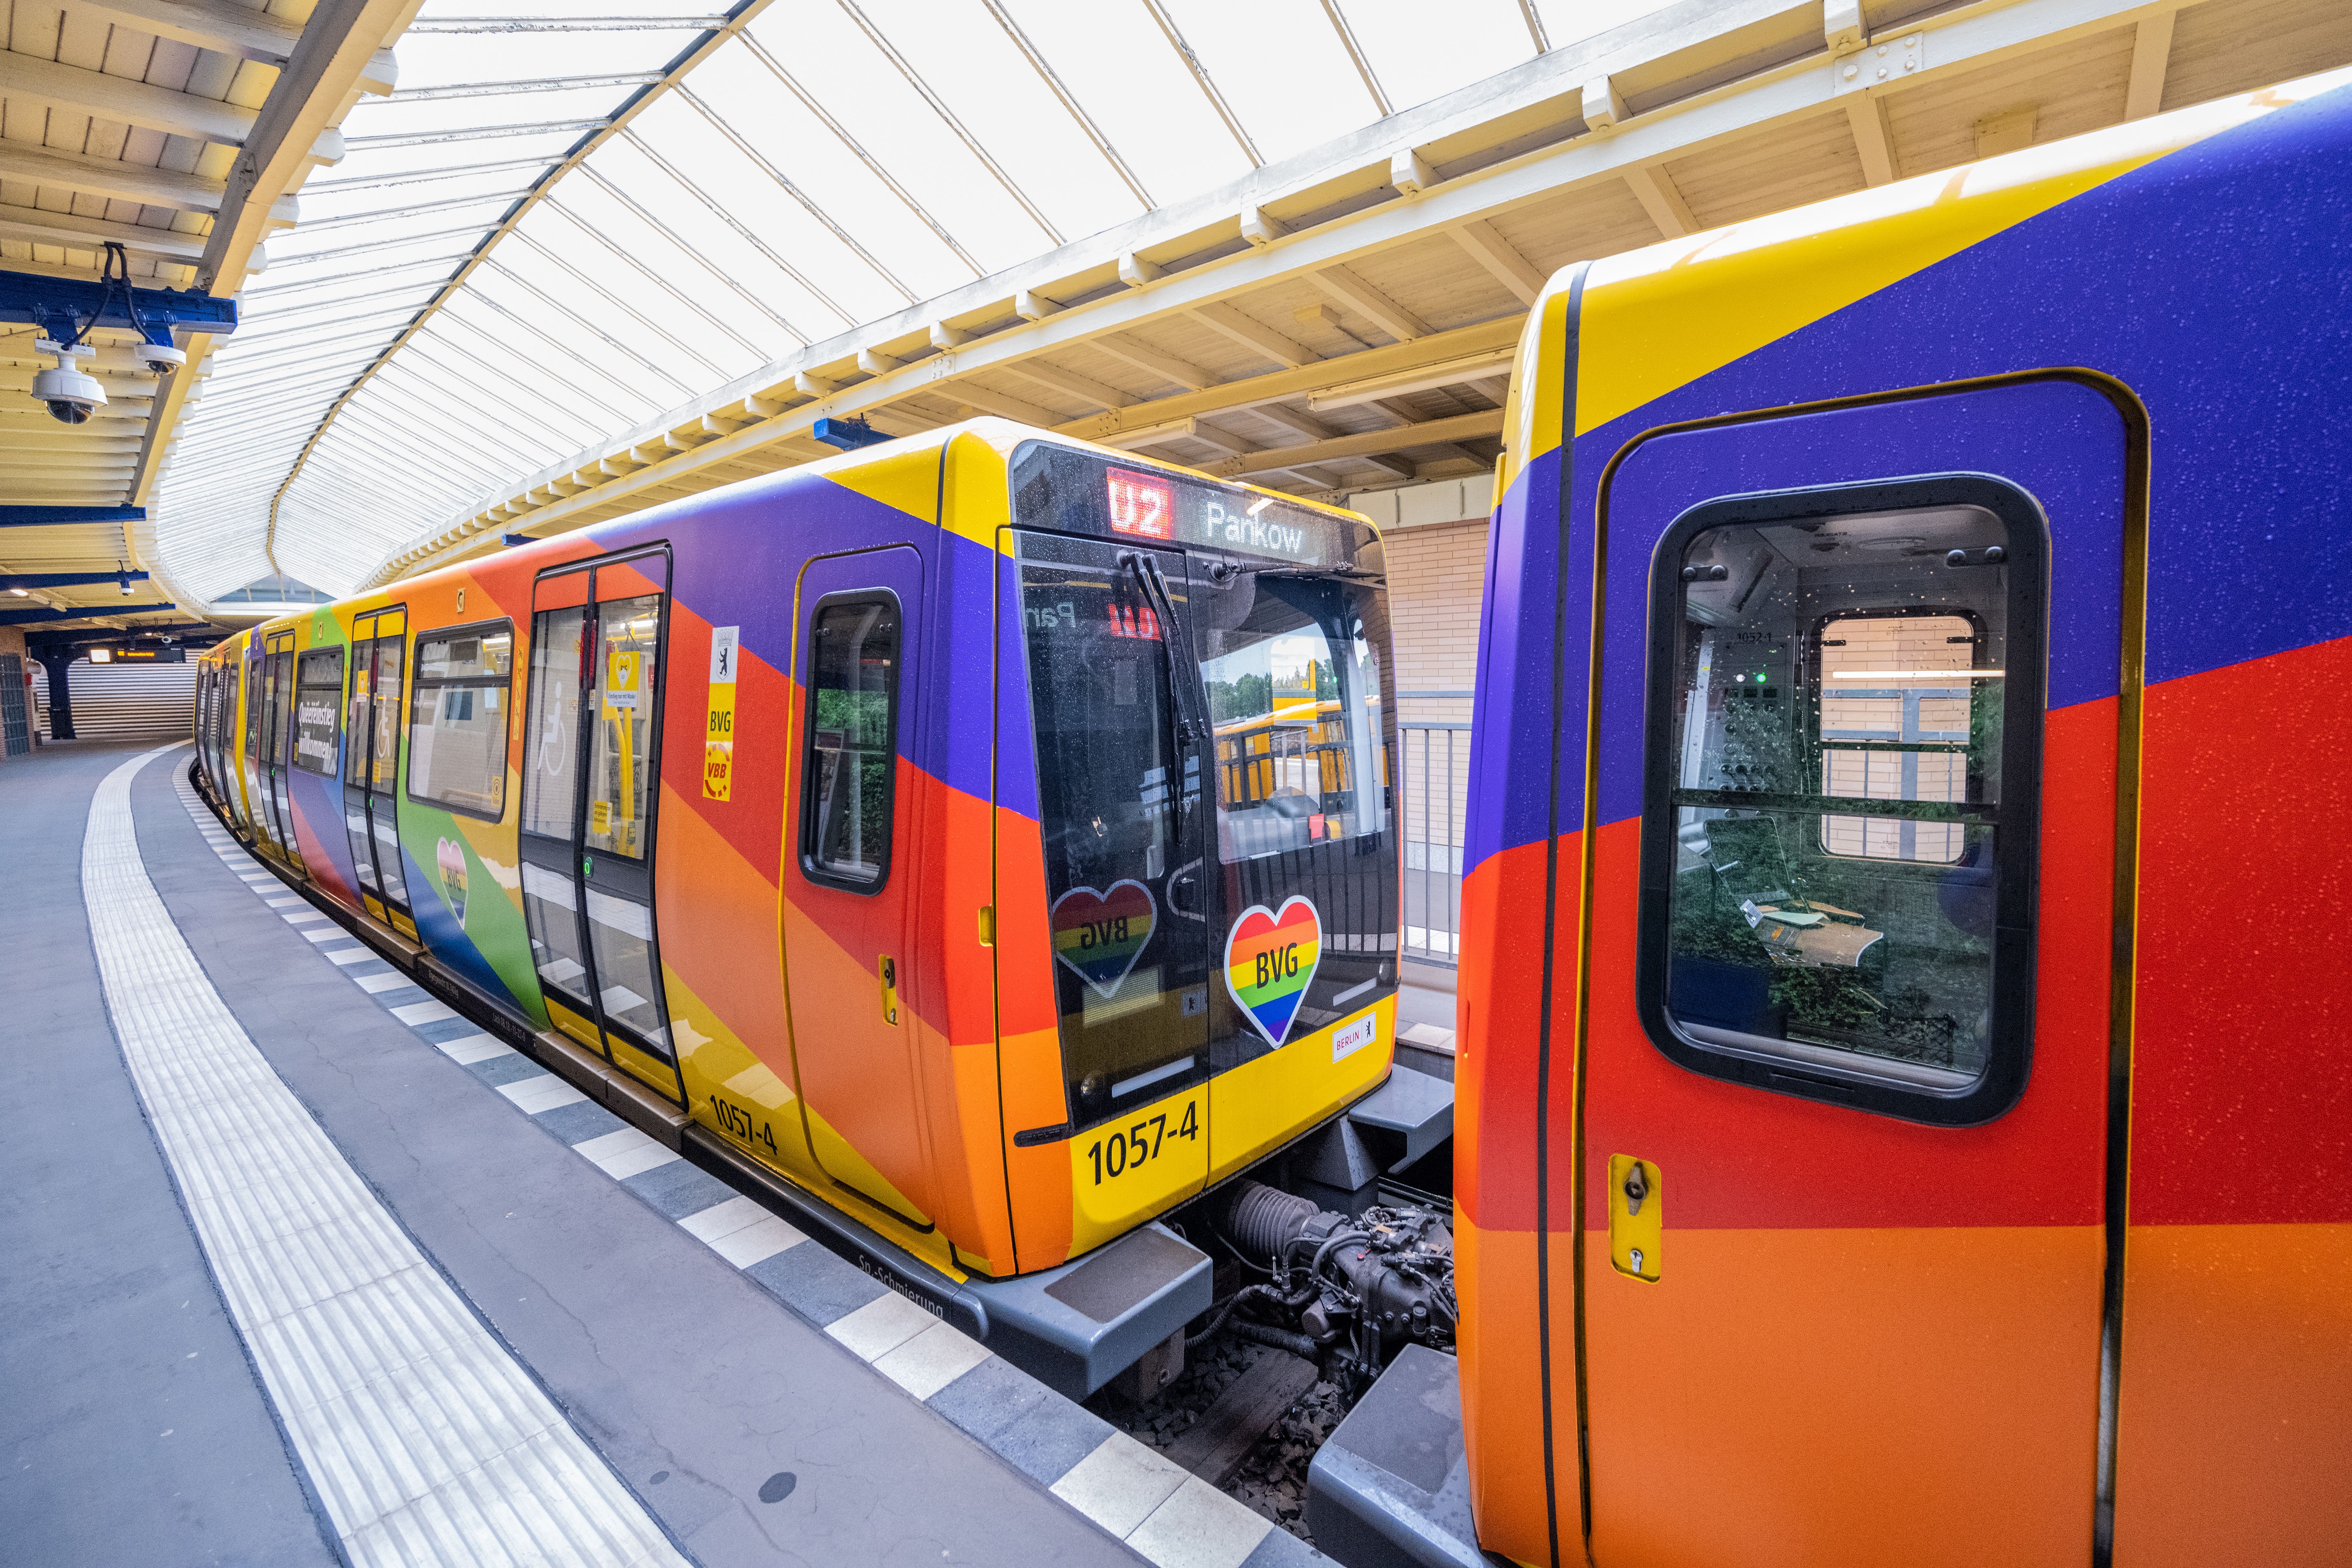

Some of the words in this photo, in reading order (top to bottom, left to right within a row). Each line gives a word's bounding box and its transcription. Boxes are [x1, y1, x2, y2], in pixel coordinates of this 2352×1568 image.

[1109, 478, 1163, 536] U2
[1206, 500, 1303, 553] Pankow
[710, 711, 731, 732] BVG
[299, 731, 332, 759] willkommen!
[708, 762, 726, 779] VBB
[446, 866, 461, 891] BVG
[1256, 943, 1298, 989] BVG
[1336, 1032, 1360, 1051] BERLIN
[710, 1094, 778, 1155] 1057-4
[1088, 1101, 1198, 1185] 1057-4
